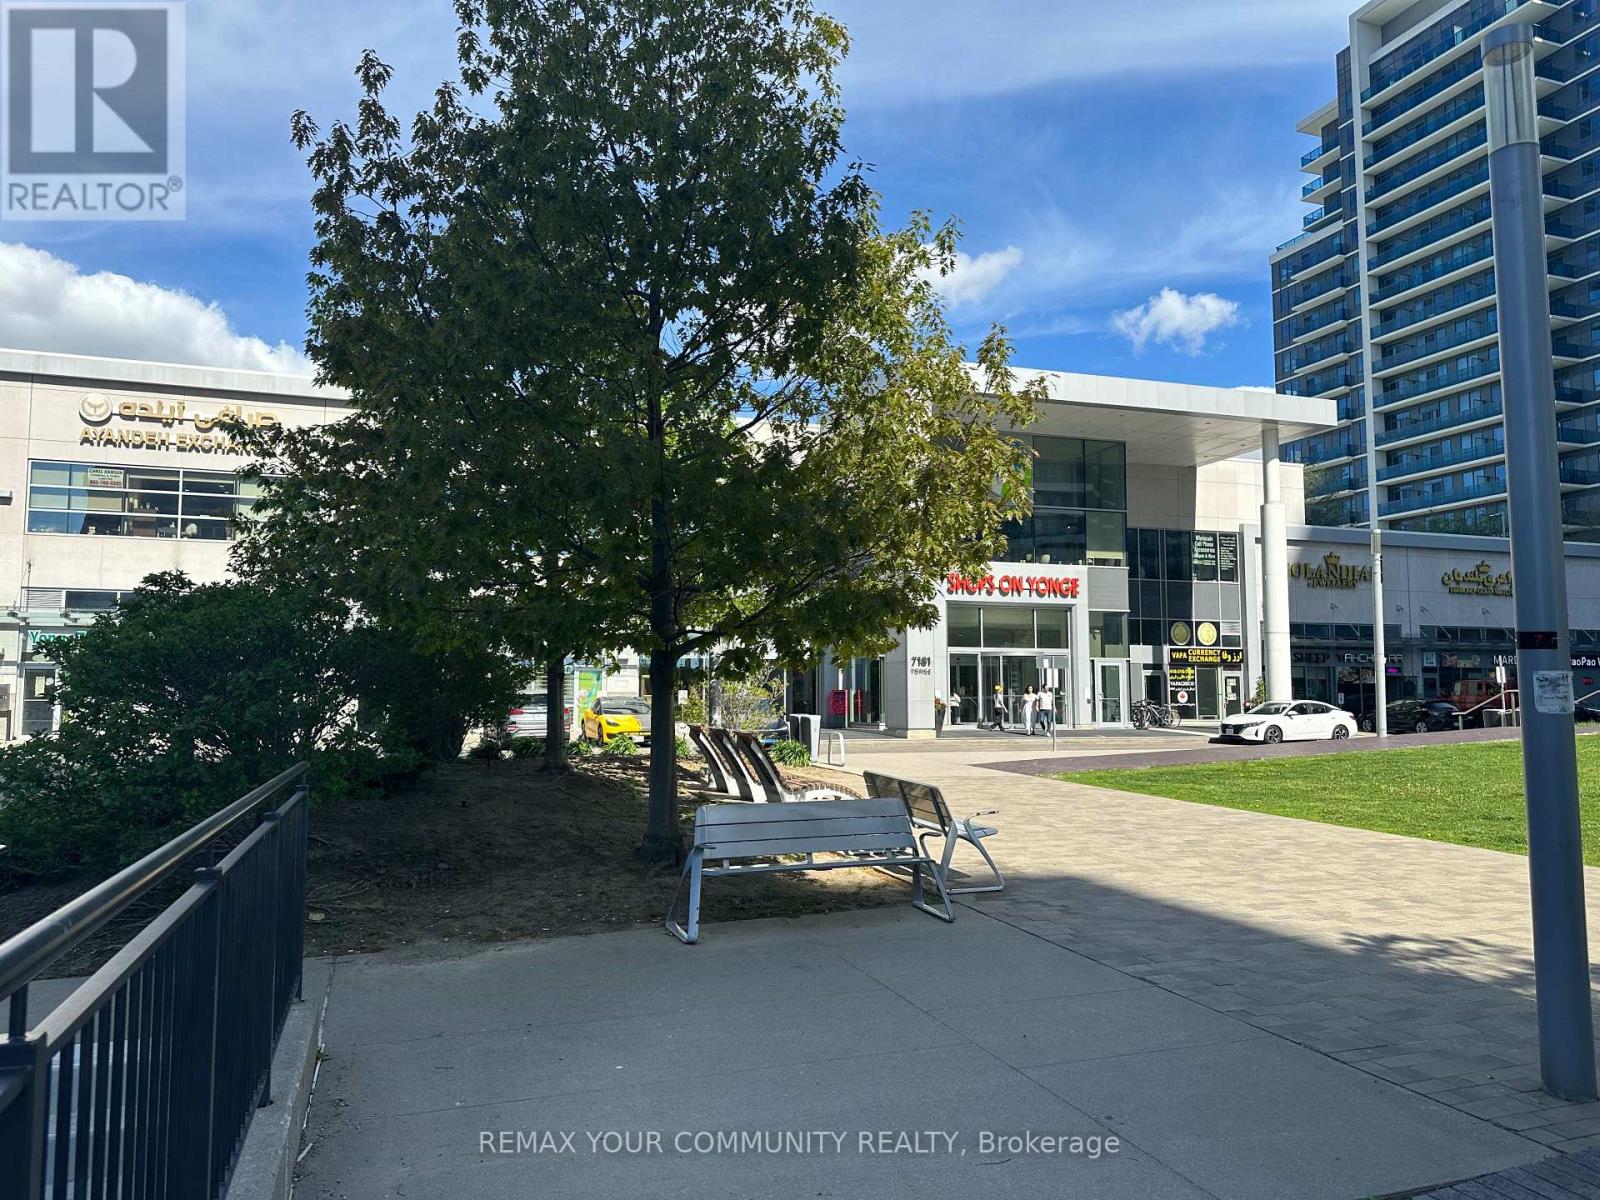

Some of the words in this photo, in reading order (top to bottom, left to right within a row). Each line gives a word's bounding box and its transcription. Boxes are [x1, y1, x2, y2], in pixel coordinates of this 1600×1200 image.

[79, 426, 170, 449] AYANDEH
[999, 575, 1024, 593] ON
[1026, 576, 1080, 596] YONGE
[1187, 648, 1221, 656] CURRENCY
[911, 656, 931, 667] 7181
[1570, 656, 1596, 666] aoPao
